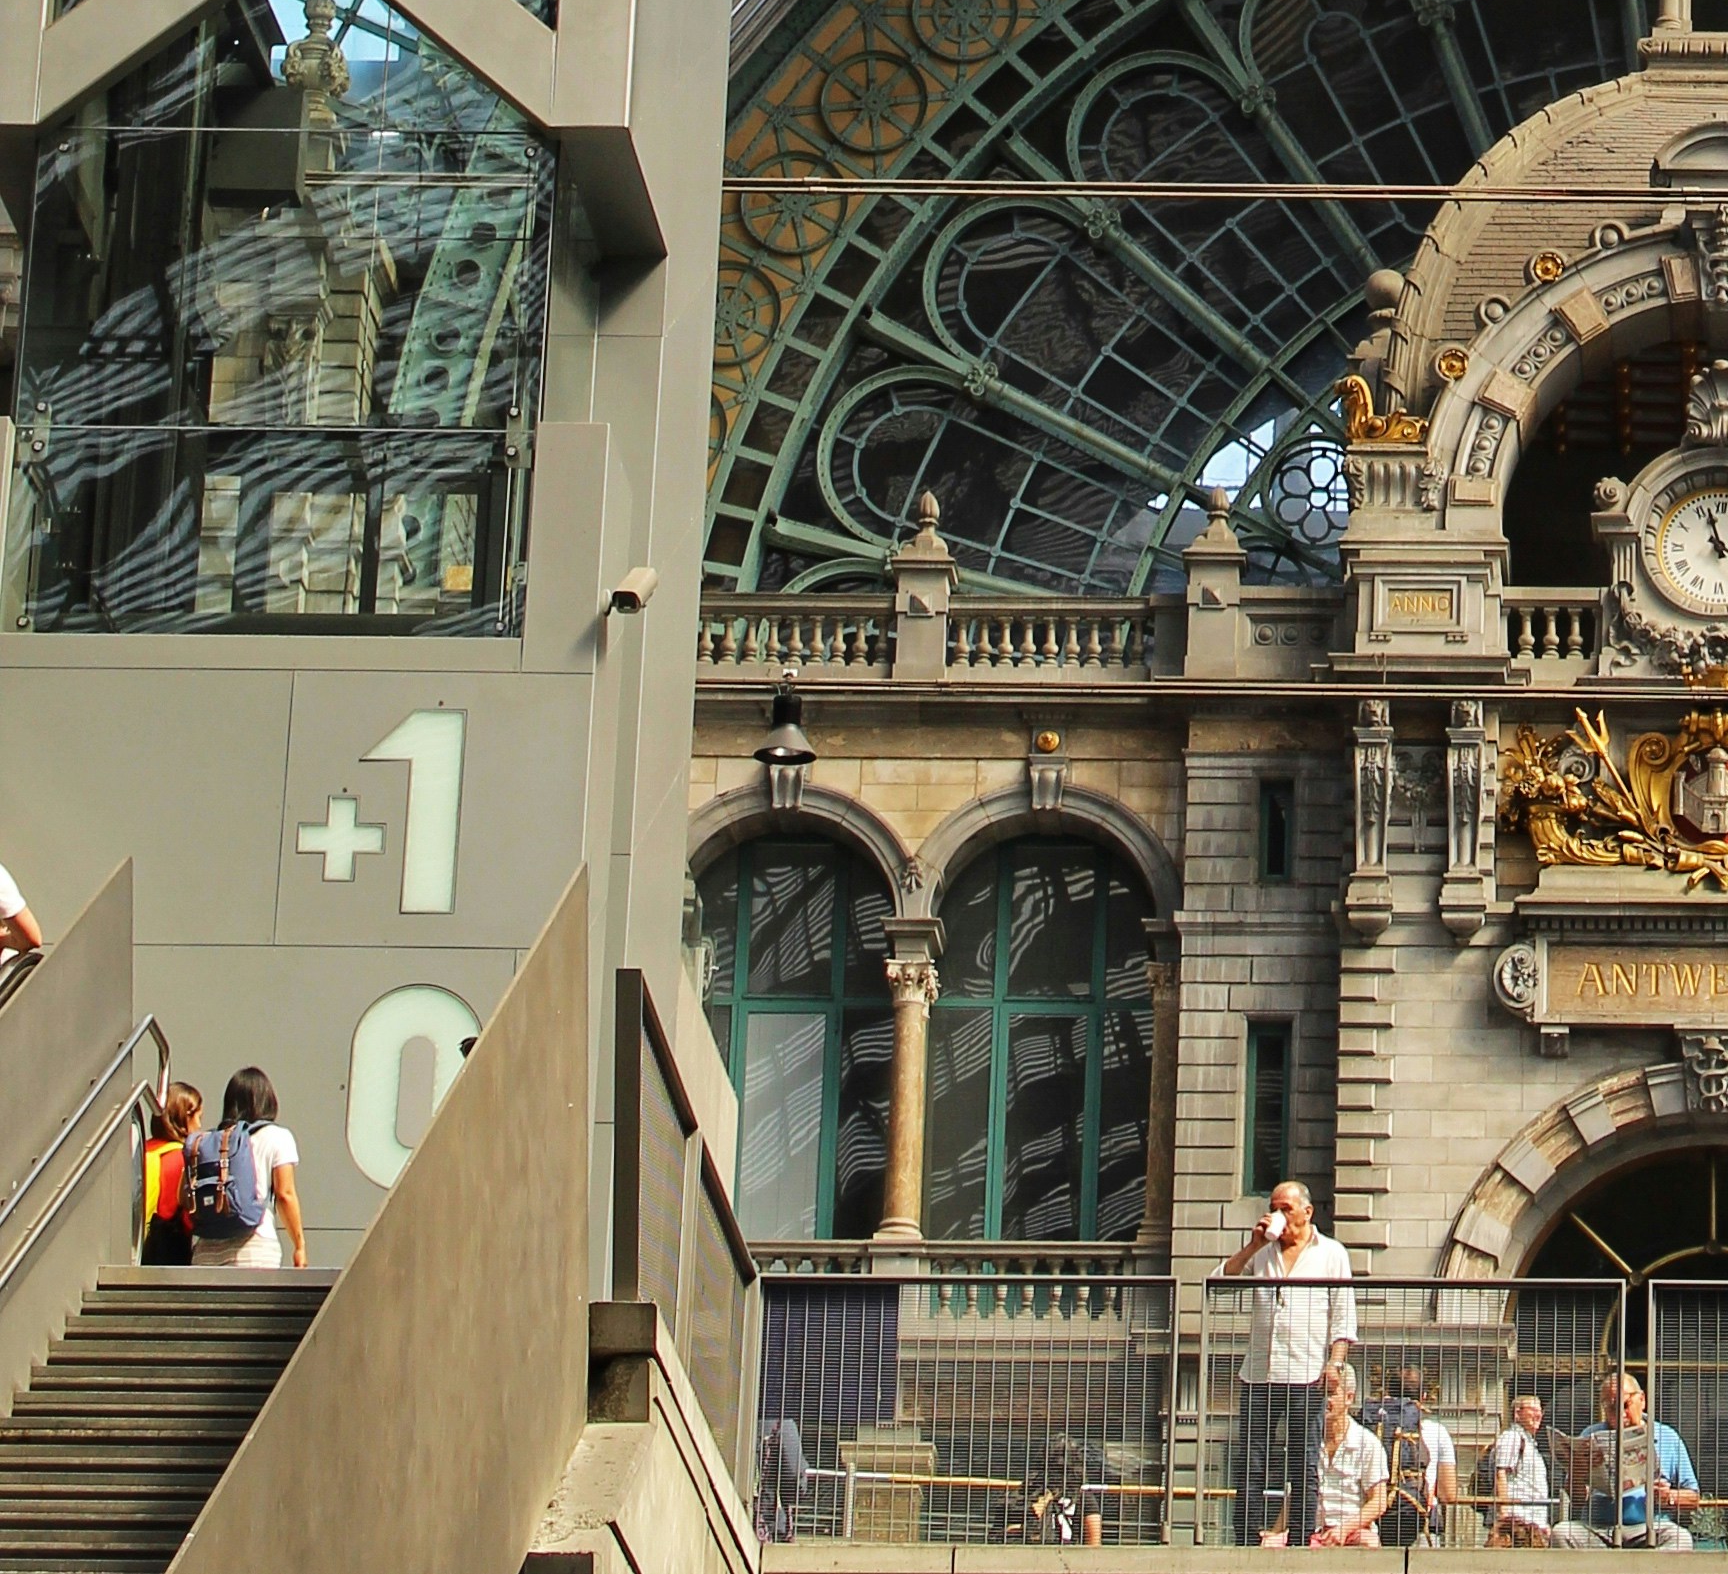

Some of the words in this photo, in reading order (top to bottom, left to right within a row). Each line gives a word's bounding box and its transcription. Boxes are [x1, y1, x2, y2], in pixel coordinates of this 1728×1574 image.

[1715, 501, 1728, 514] XII
[1391, 595, 1450, 613] ANNO
[296, 709, 468, 915] +1
